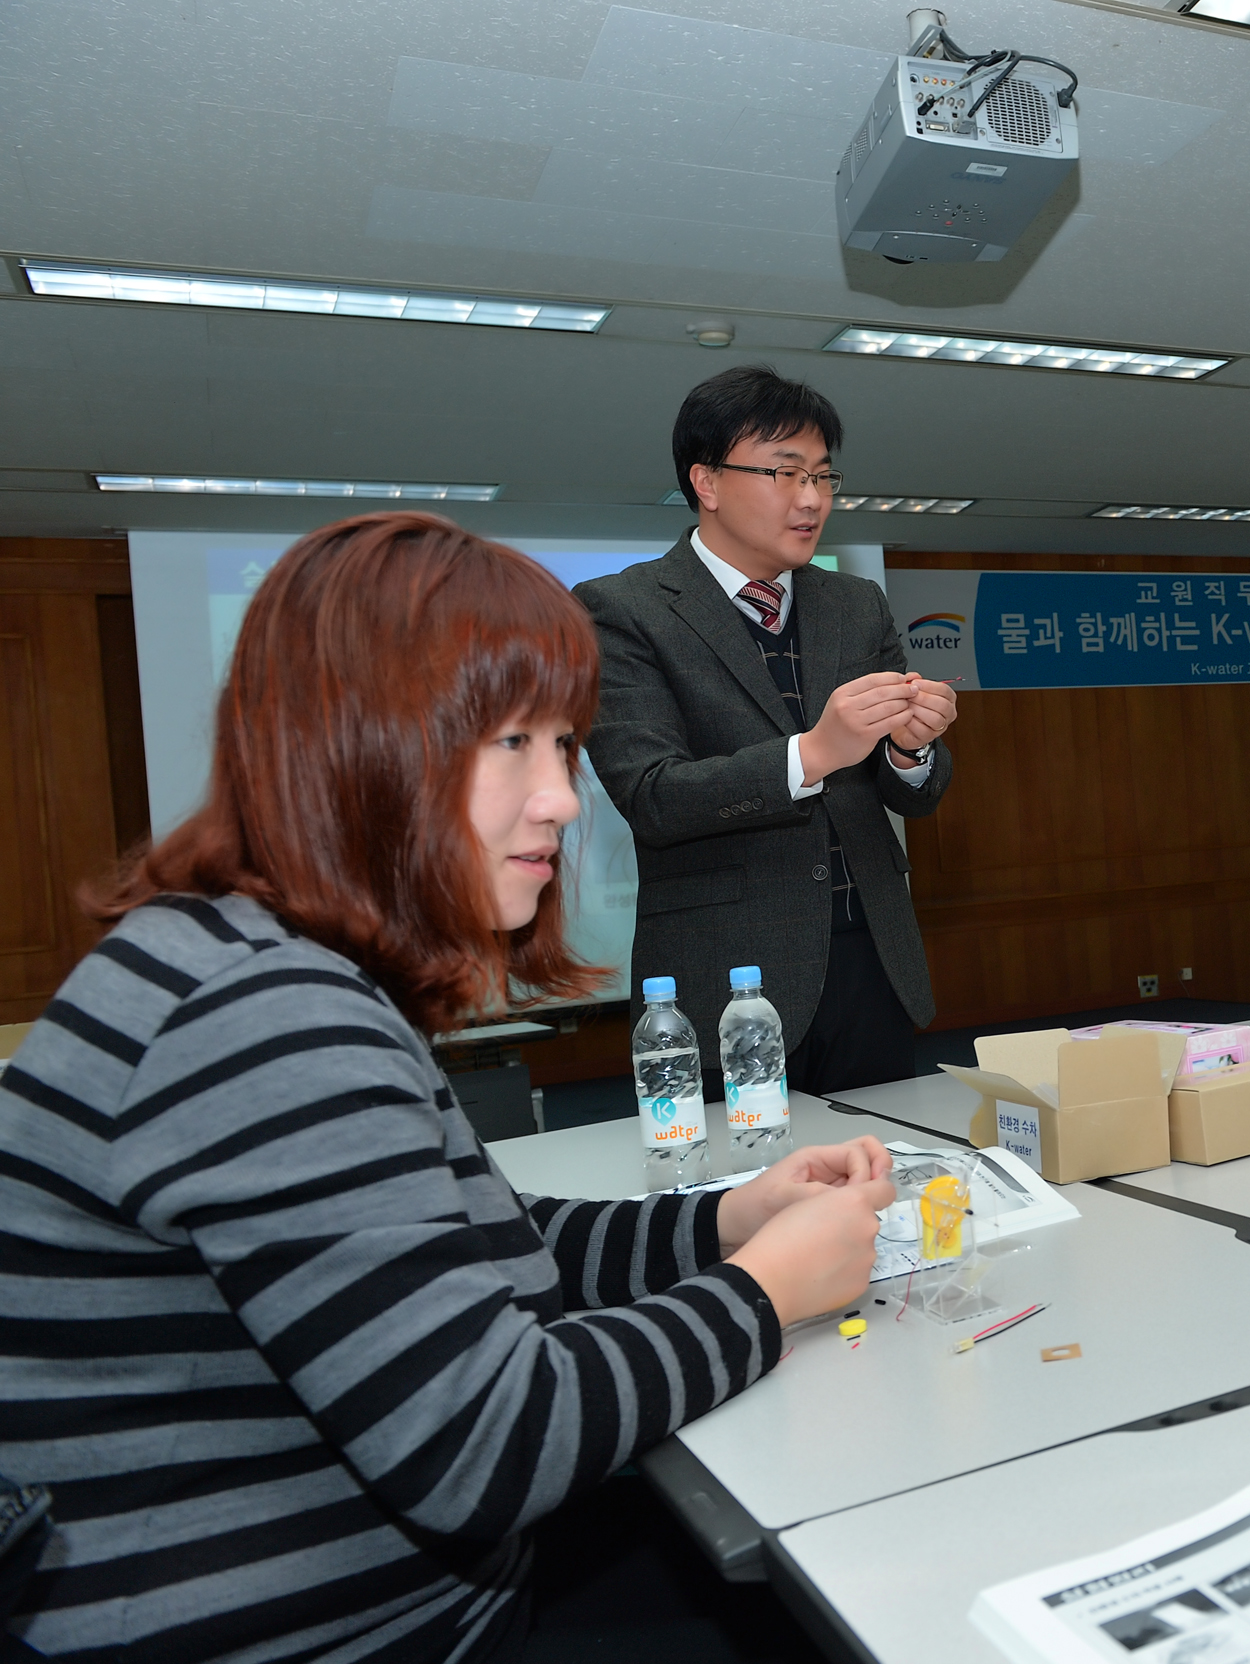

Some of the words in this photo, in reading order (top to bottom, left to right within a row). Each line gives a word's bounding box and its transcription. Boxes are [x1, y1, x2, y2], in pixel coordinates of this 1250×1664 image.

[997, 612, 1064, 654] 물과
[1076, 611, 1201, 653] 함께하는
[909, 634, 962, 650] water
[1191, 662, 1244, 676] K-water
[655, 1101, 672, 1121] K
[728, 1110, 762, 1127] water
[655, 1125, 699, 1141] water
[998, 1114, 1020, 1134] 친환경
[1022, 1119, 1037, 1138] 수차
[1005, 1139, 1032, 1157] K-water
